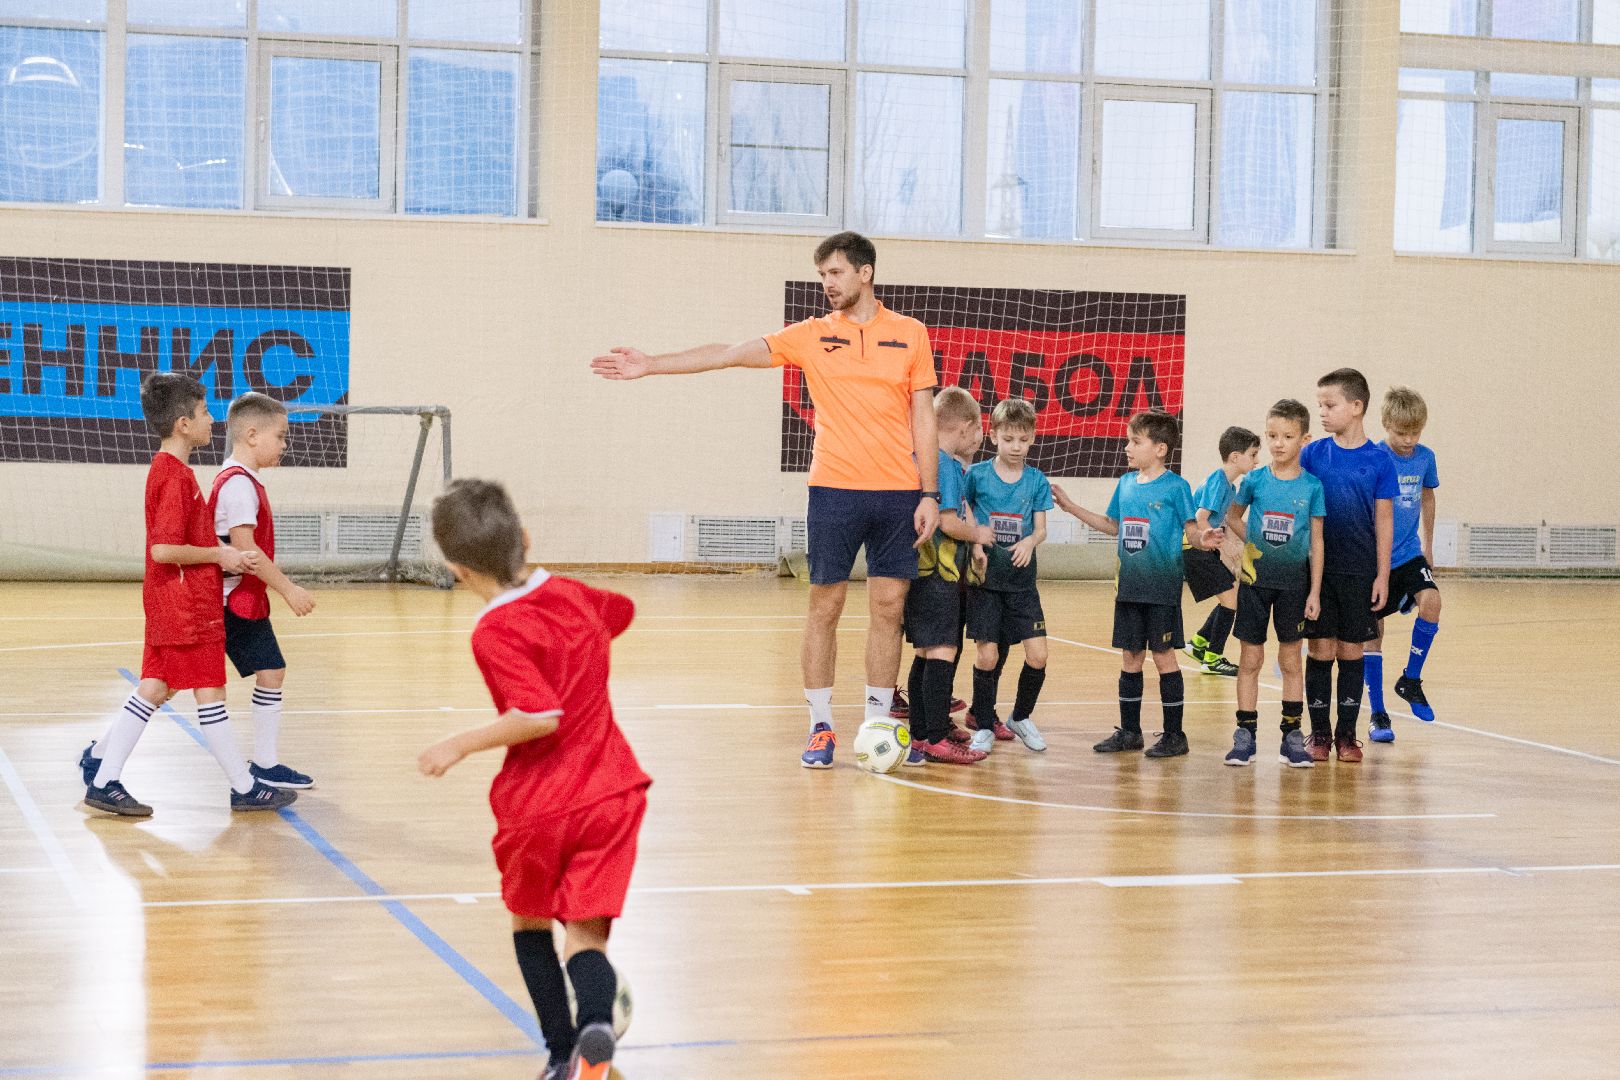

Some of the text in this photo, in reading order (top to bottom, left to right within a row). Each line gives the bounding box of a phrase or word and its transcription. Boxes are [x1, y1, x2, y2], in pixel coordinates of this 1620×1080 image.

[0, 321, 315, 402] ННИС
[993, 520, 1017, 532] RAM
[1267, 518, 1289, 531] RAM
[1126, 525, 1143, 537] RAM
[1265, 532, 1287, 542] TRUCK
